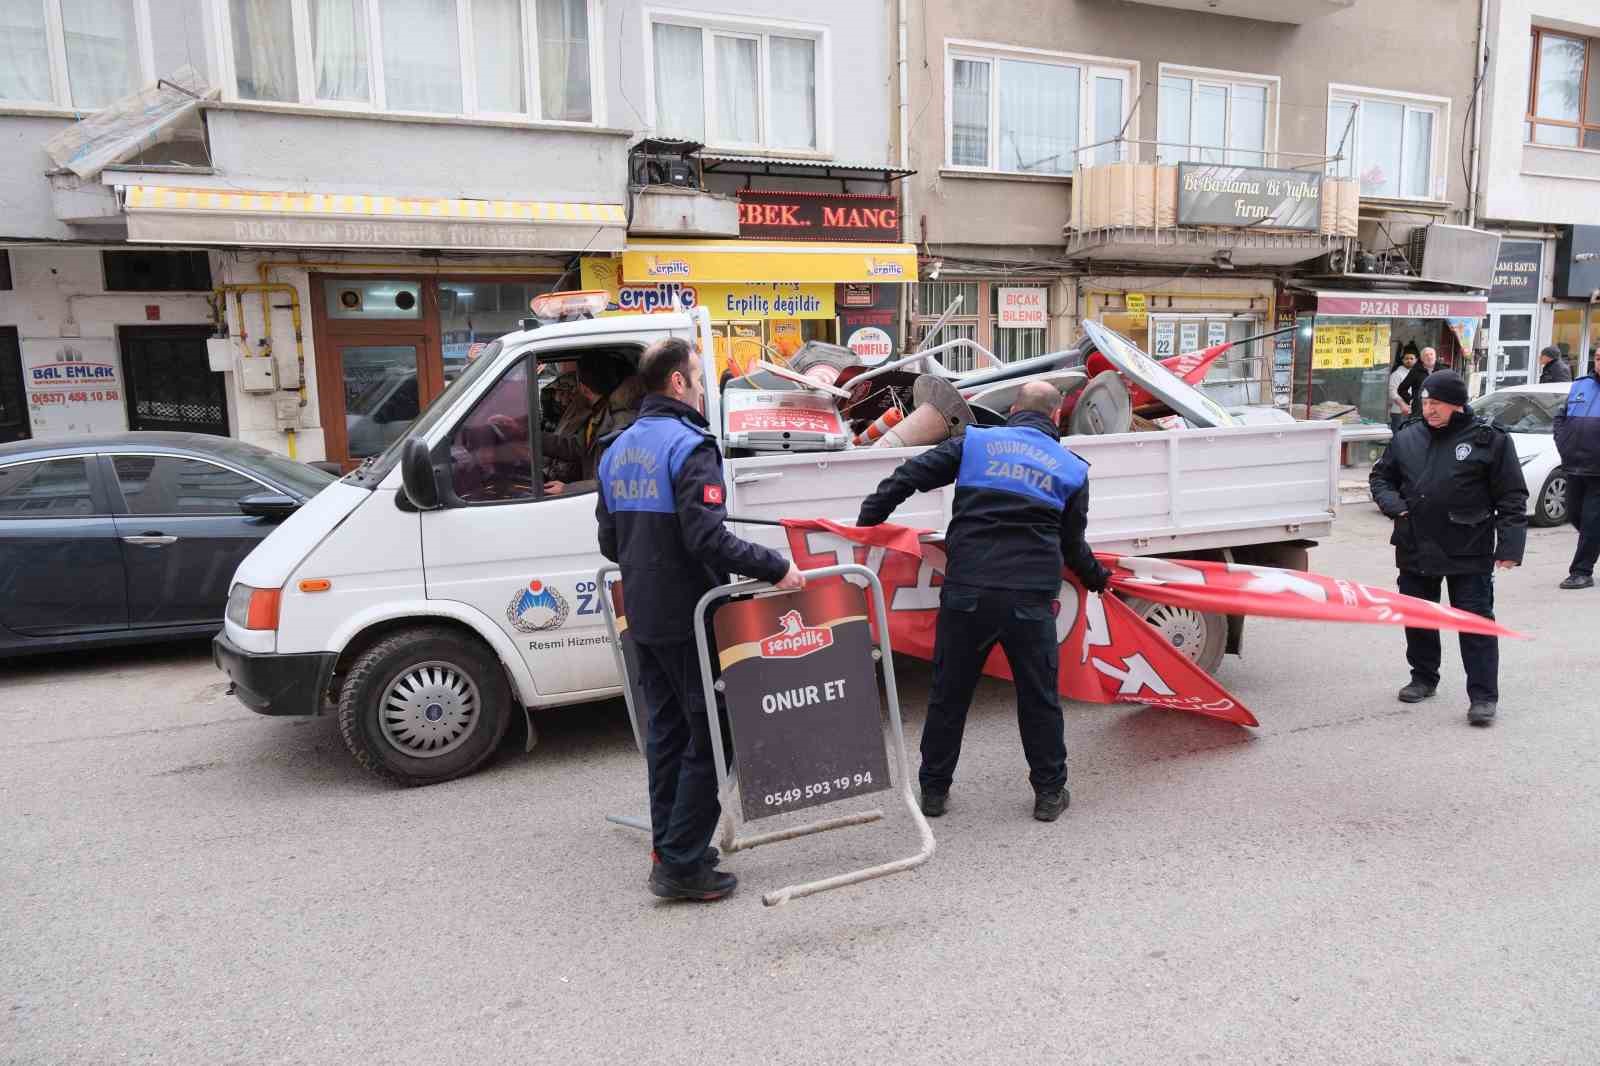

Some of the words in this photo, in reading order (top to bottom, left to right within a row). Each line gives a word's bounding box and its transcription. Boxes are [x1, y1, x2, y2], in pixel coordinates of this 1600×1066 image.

[1266, 180, 1281, 197] Bi
[1283, 180, 1319, 202] Yufka
[727, 294, 769, 316] Erpiliç
[773, 294, 820, 316] değildir
[1360, 301, 1399, 315] PAZAR
[1407, 303, 1449, 316] KASABI
[1157, 340, 1171, 353] 22
[32, 367, 62, 380] BAL
[65, 365, 114, 378] EMLAK
[91, 391, 103, 401] 10
[529, 639, 564, 650] Resmi
[761, 685, 820, 714] ONUR
[824, 679, 846, 701] ET
[764, 788, 801, 806] 0549
[805, 781, 831, 799] 503
[834, 776, 850, 789] 19
[853, 771, 873, 786] 94
